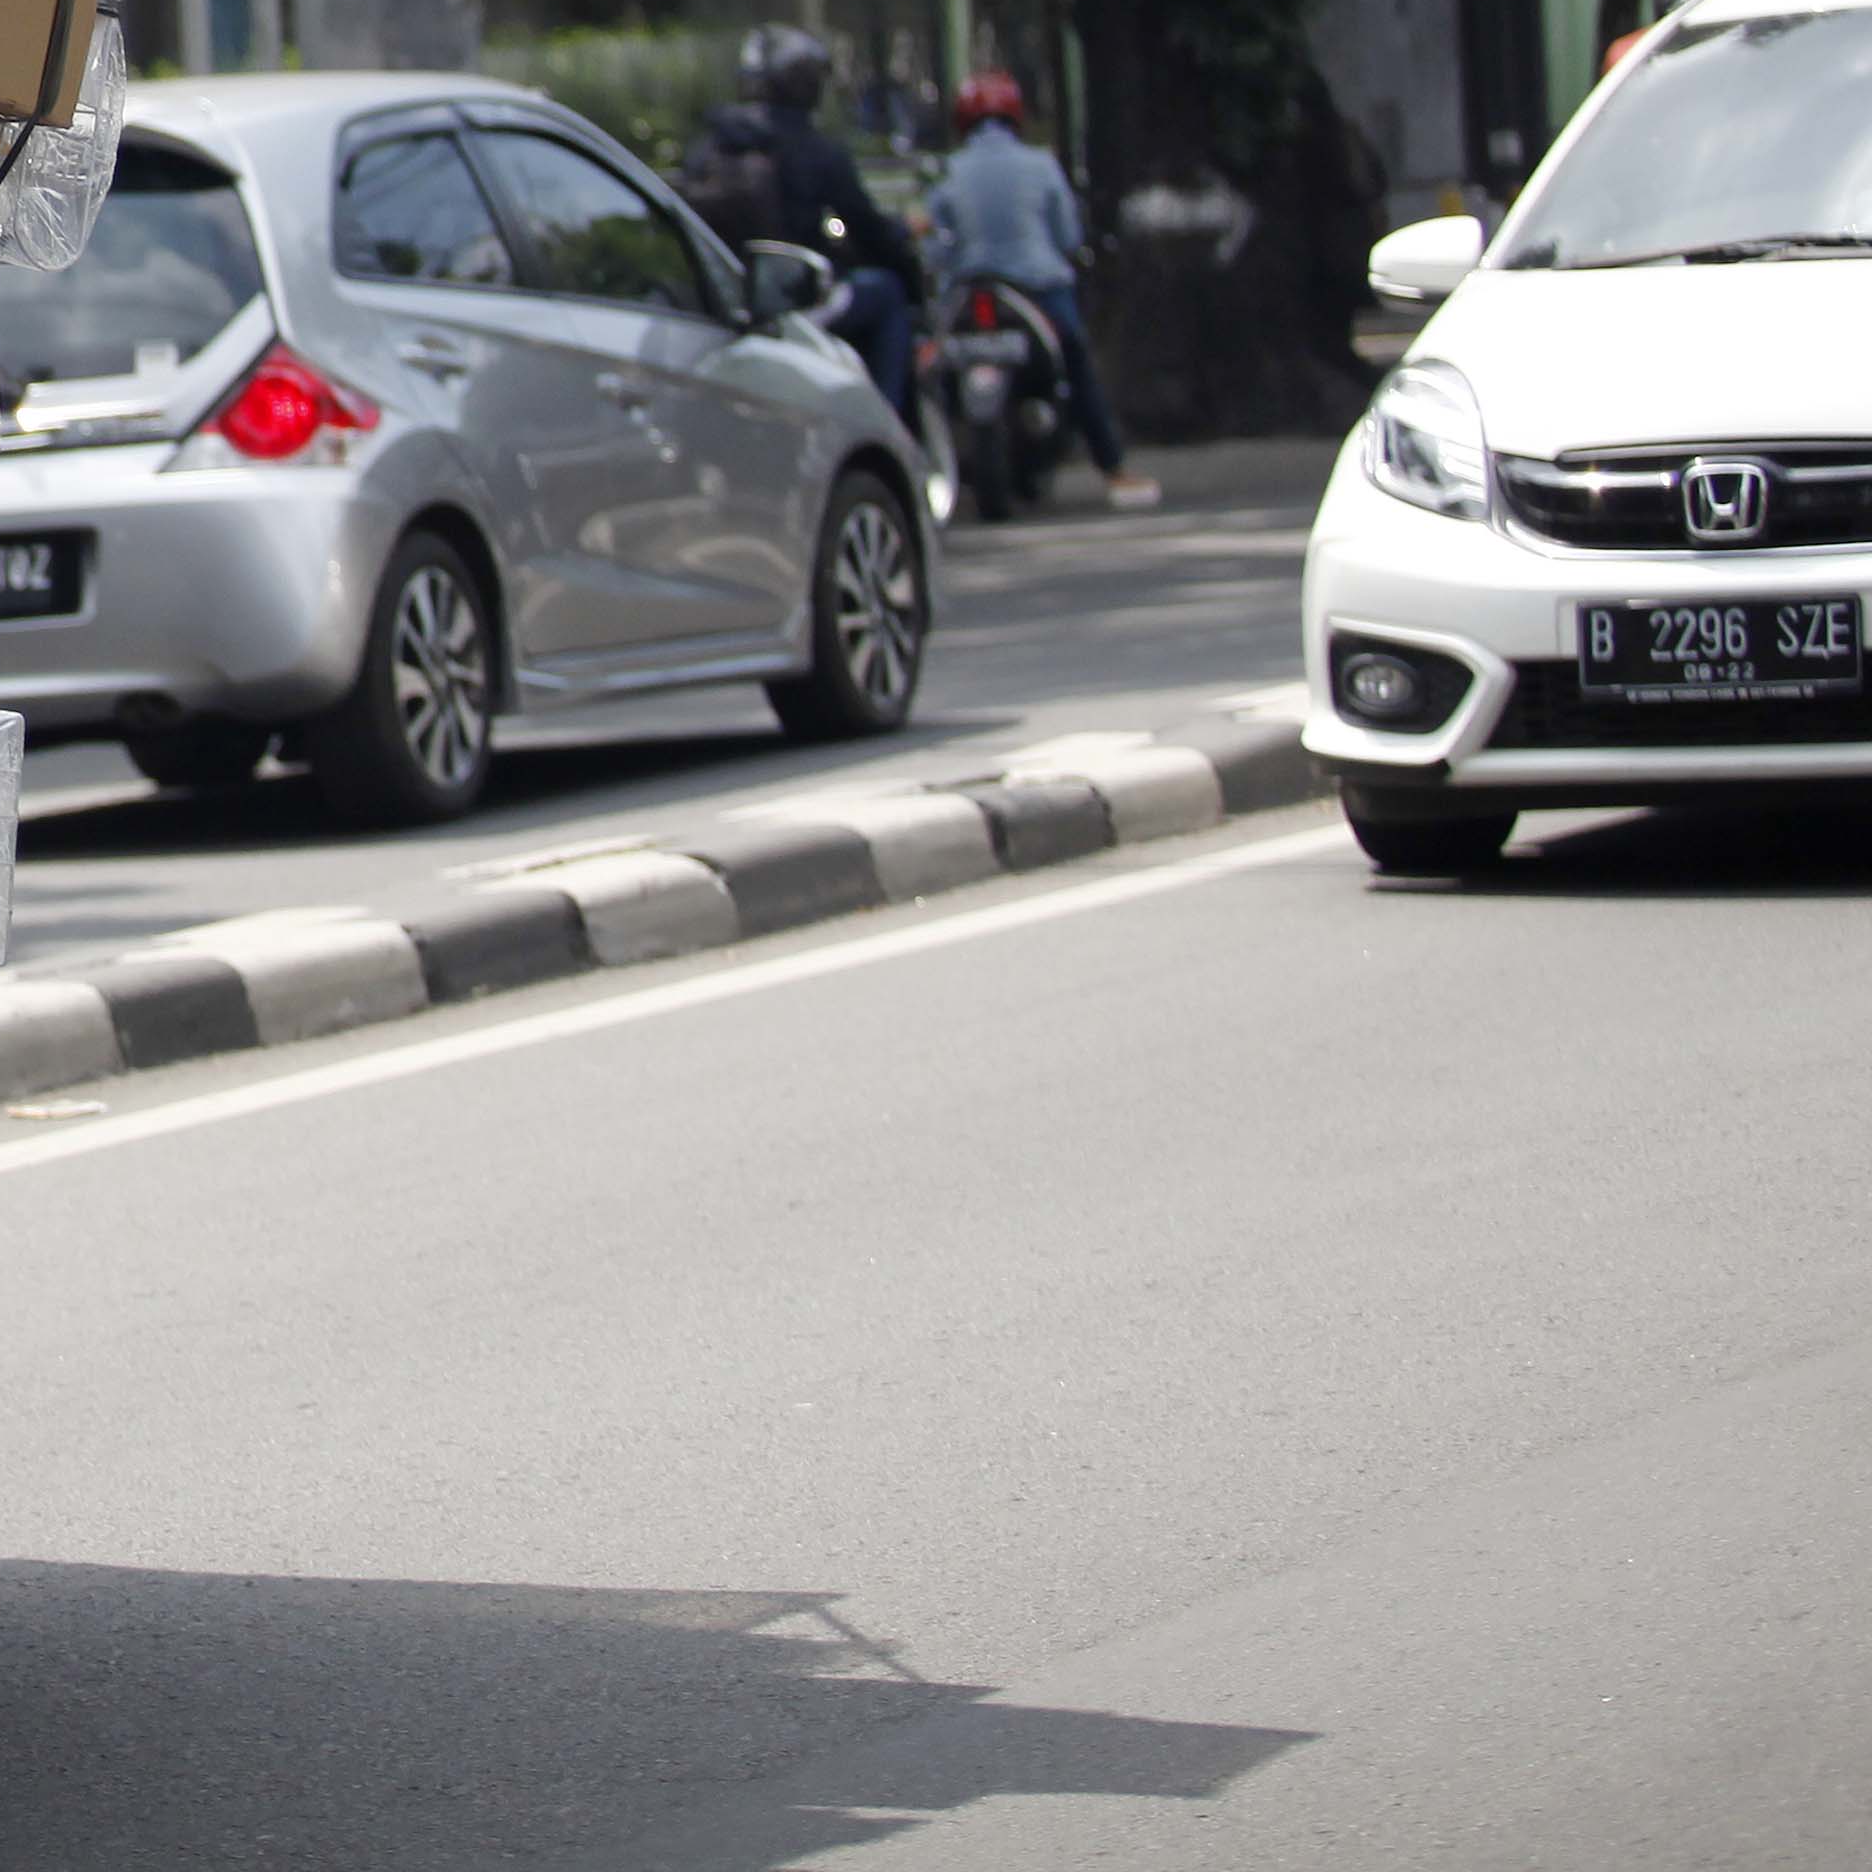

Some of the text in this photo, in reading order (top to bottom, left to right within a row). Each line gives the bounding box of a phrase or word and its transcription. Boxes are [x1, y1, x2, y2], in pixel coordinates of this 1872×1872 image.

[1590, 602, 1851, 663] B 2296 SZE
